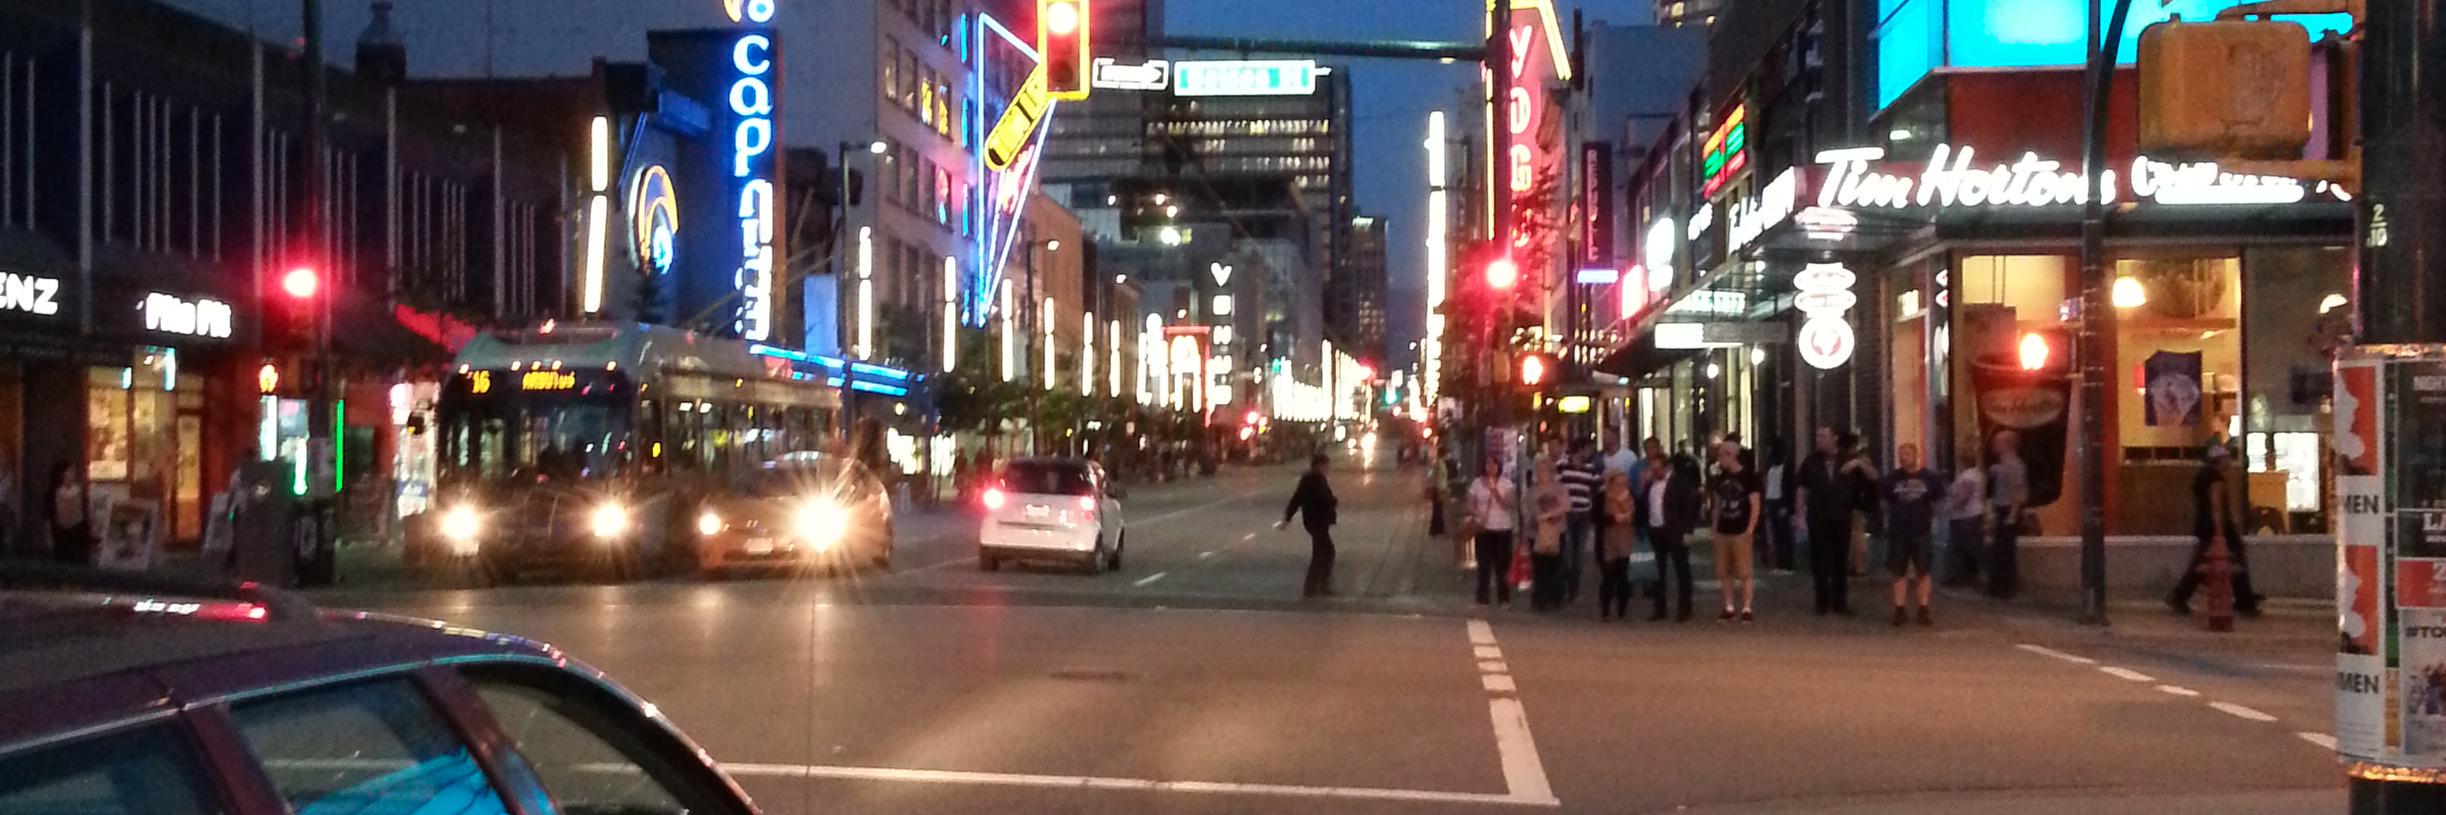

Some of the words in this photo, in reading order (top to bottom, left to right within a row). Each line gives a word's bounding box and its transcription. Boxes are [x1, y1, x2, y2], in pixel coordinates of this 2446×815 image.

[1815, 147, 1914, 209] Tim
[1916, 143, 2117, 207] Hortons
[2372, 203, 2385, 222] 2
[472, 370, 491, 393] 16
[2406, 626, 2446, 638] #TO
